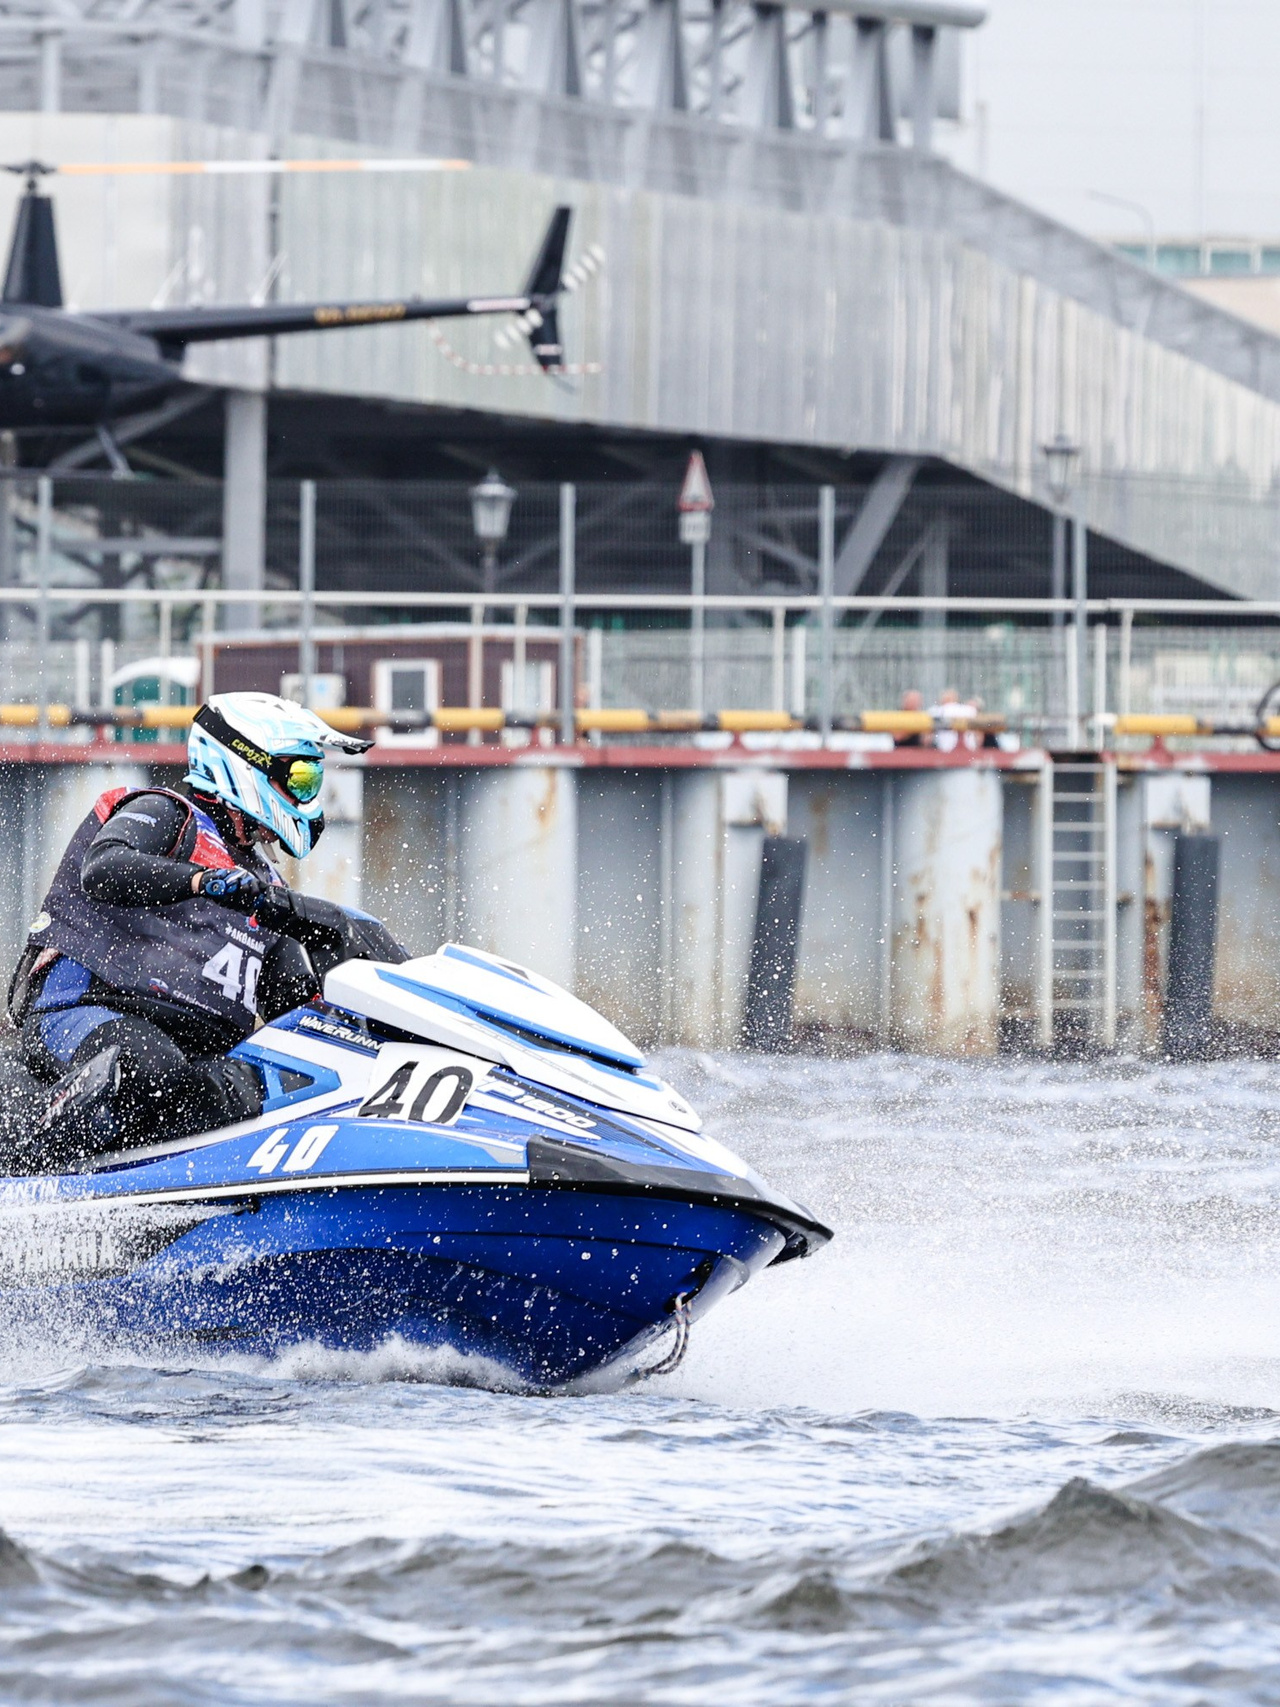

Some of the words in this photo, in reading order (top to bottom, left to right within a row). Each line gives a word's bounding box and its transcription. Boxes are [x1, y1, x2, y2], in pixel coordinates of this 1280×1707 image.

[299, 1015, 382, 1050] WAVERUNN
[357, 1061, 473, 1124] 40
[475, 1077, 597, 1129] P1800
[246, 1124, 339, 1175] 40
[9, 1231, 116, 1273] YAMAHA
